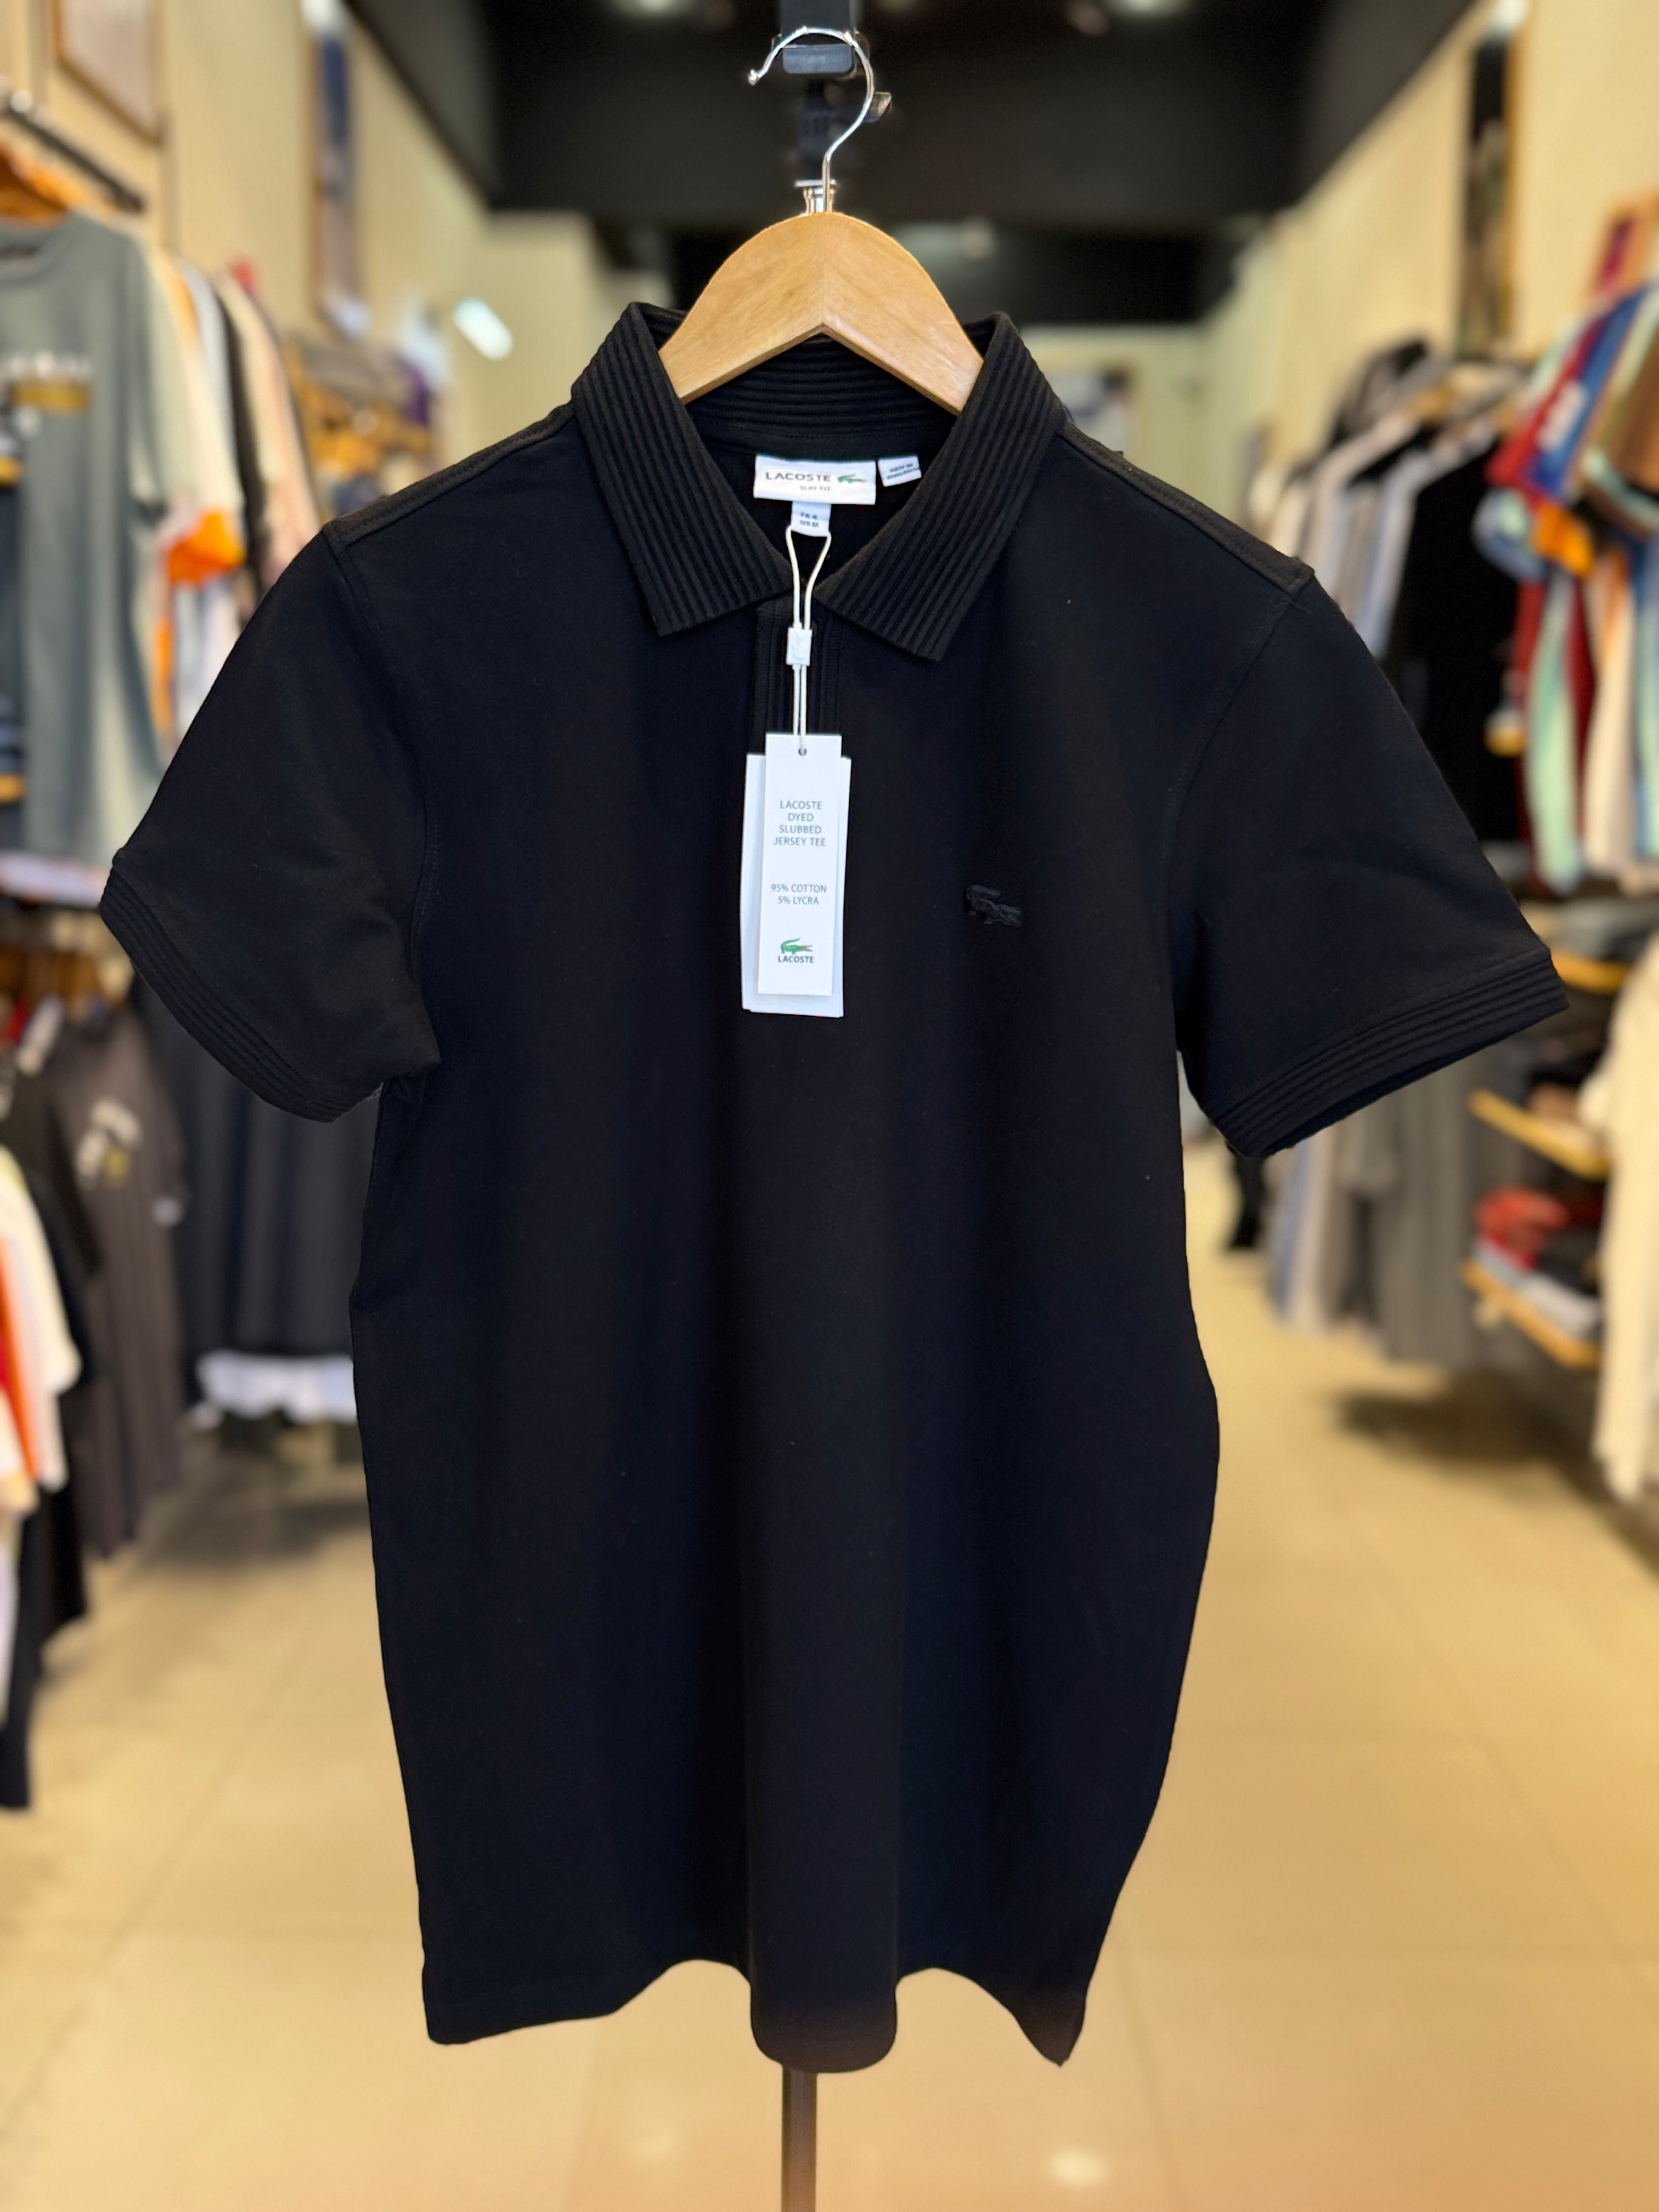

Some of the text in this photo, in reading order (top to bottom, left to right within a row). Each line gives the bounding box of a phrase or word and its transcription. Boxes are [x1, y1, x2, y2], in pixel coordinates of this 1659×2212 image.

[765, 472, 831, 482] LACOSTE
[780, 800, 822, 810] LACOSTE
[788, 813, 814, 822] DYED
[778, 825, 822, 834] SLUBBED
[773, 837, 826, 847] JERSEY TEE
[771, 884, 827, 893] 95% COTTON
[777, 896, 819, 905] 5% LYCRA
[778, 955, 814, 963] LACOSTE
